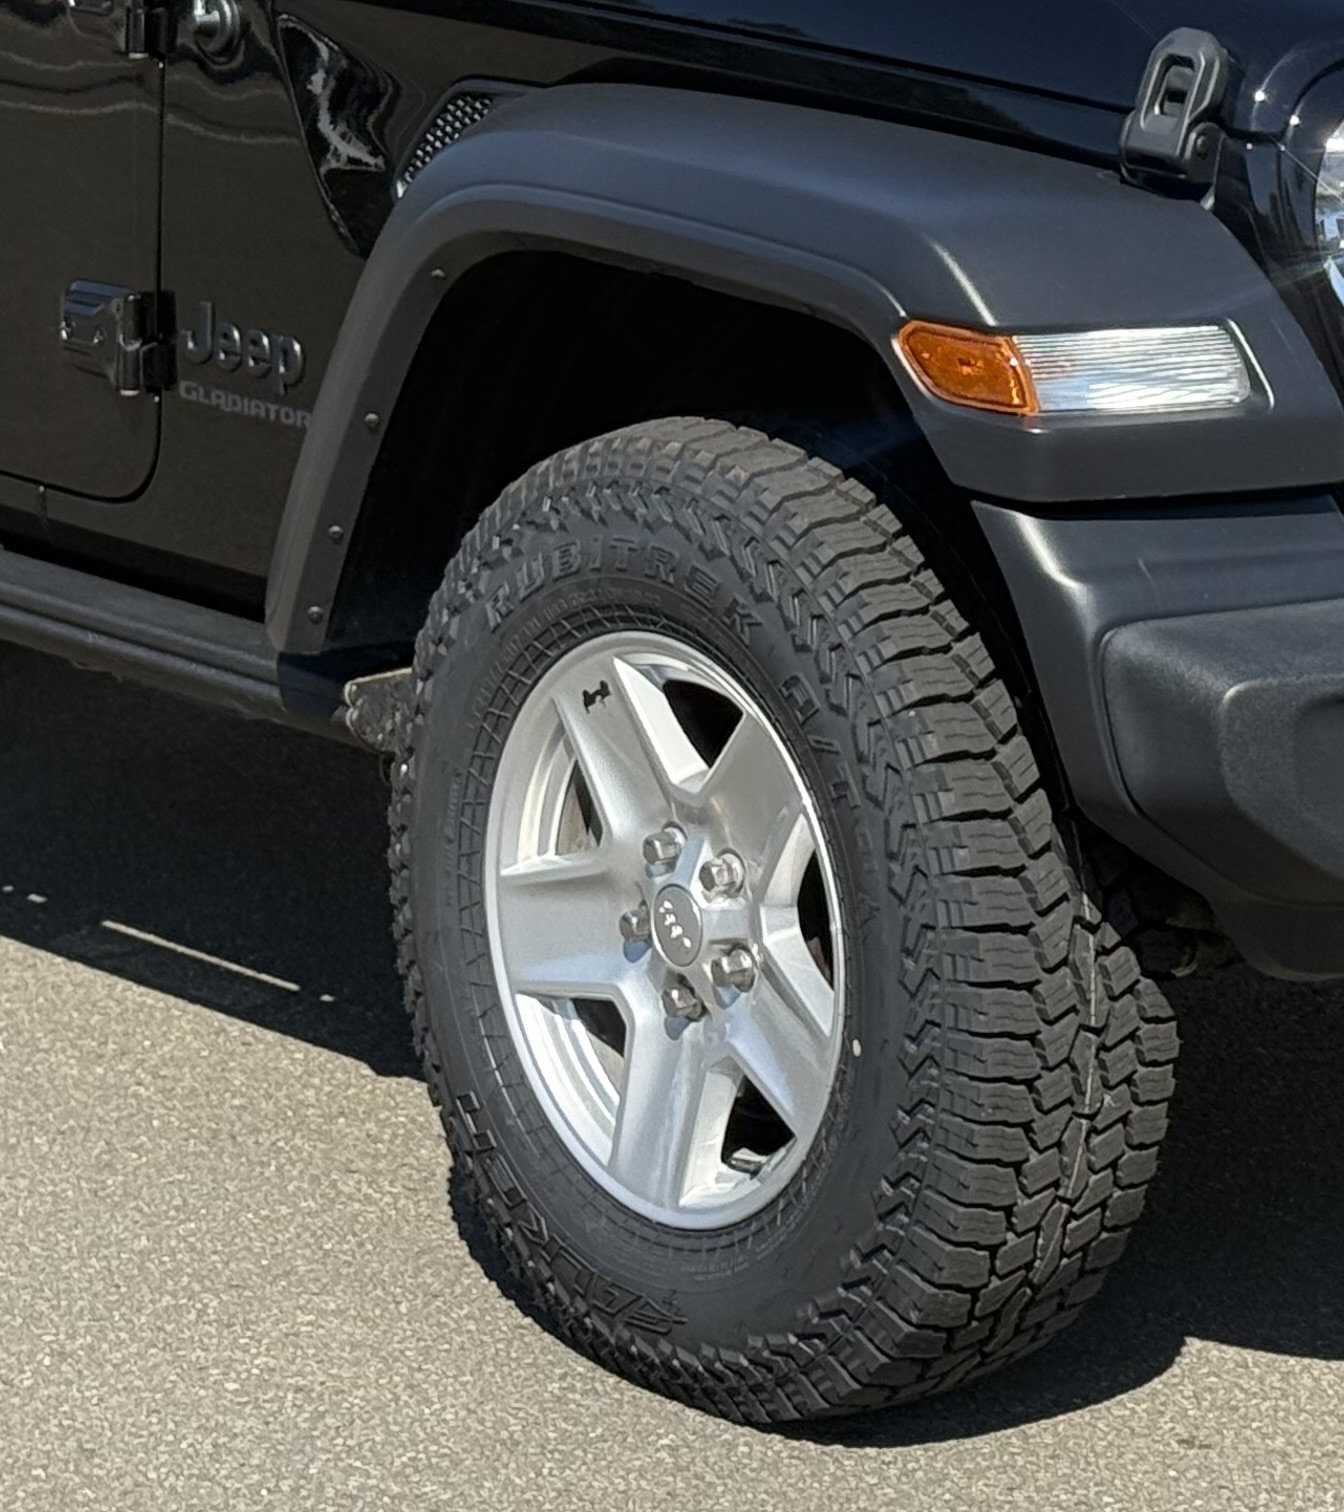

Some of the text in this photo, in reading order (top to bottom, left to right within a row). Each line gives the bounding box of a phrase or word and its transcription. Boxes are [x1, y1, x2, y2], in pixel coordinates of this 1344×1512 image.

[178, 300, 305, 397] Jeep
[179, 380, 313, 427] GLADIATOR
[485, 534, 763, 646] RUBITREK
